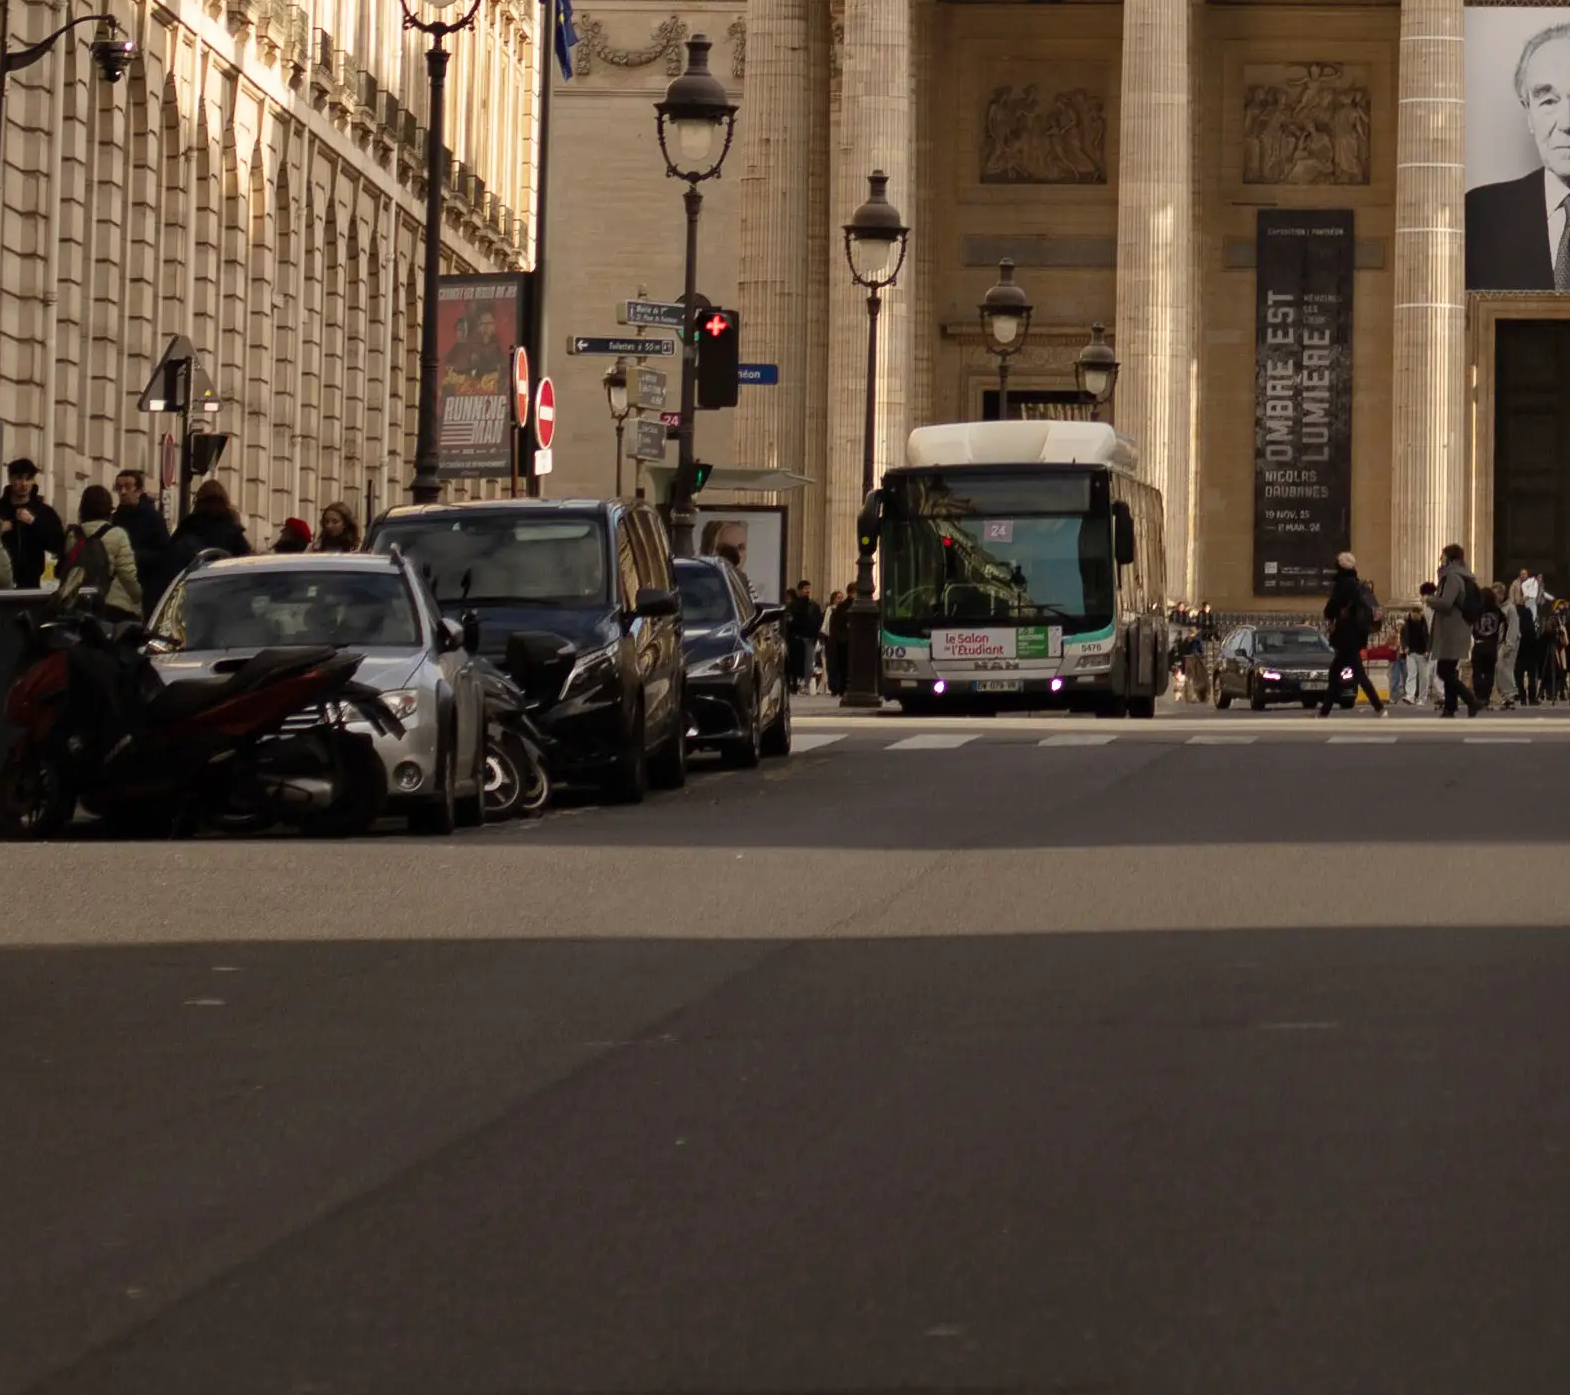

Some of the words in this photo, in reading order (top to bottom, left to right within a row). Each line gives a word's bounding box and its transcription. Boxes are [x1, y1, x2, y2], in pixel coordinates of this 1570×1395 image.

[1266, 289, 1295, 345] EST
[444, 395, 508, 422] RUNNING
[1266, 358, 1296, 462] OMBRE
[664, 415, 680, 426] 24
[470, 420, 504, 446] MAN
[1265, 469, 1318, 484] NICOLAS
[1265, 485, 1330, 499] DAUBANES
[990, 523, 1007, 537] 24
[945, 633, 955, 645] le
[958, 632, 990, 645] Salon
